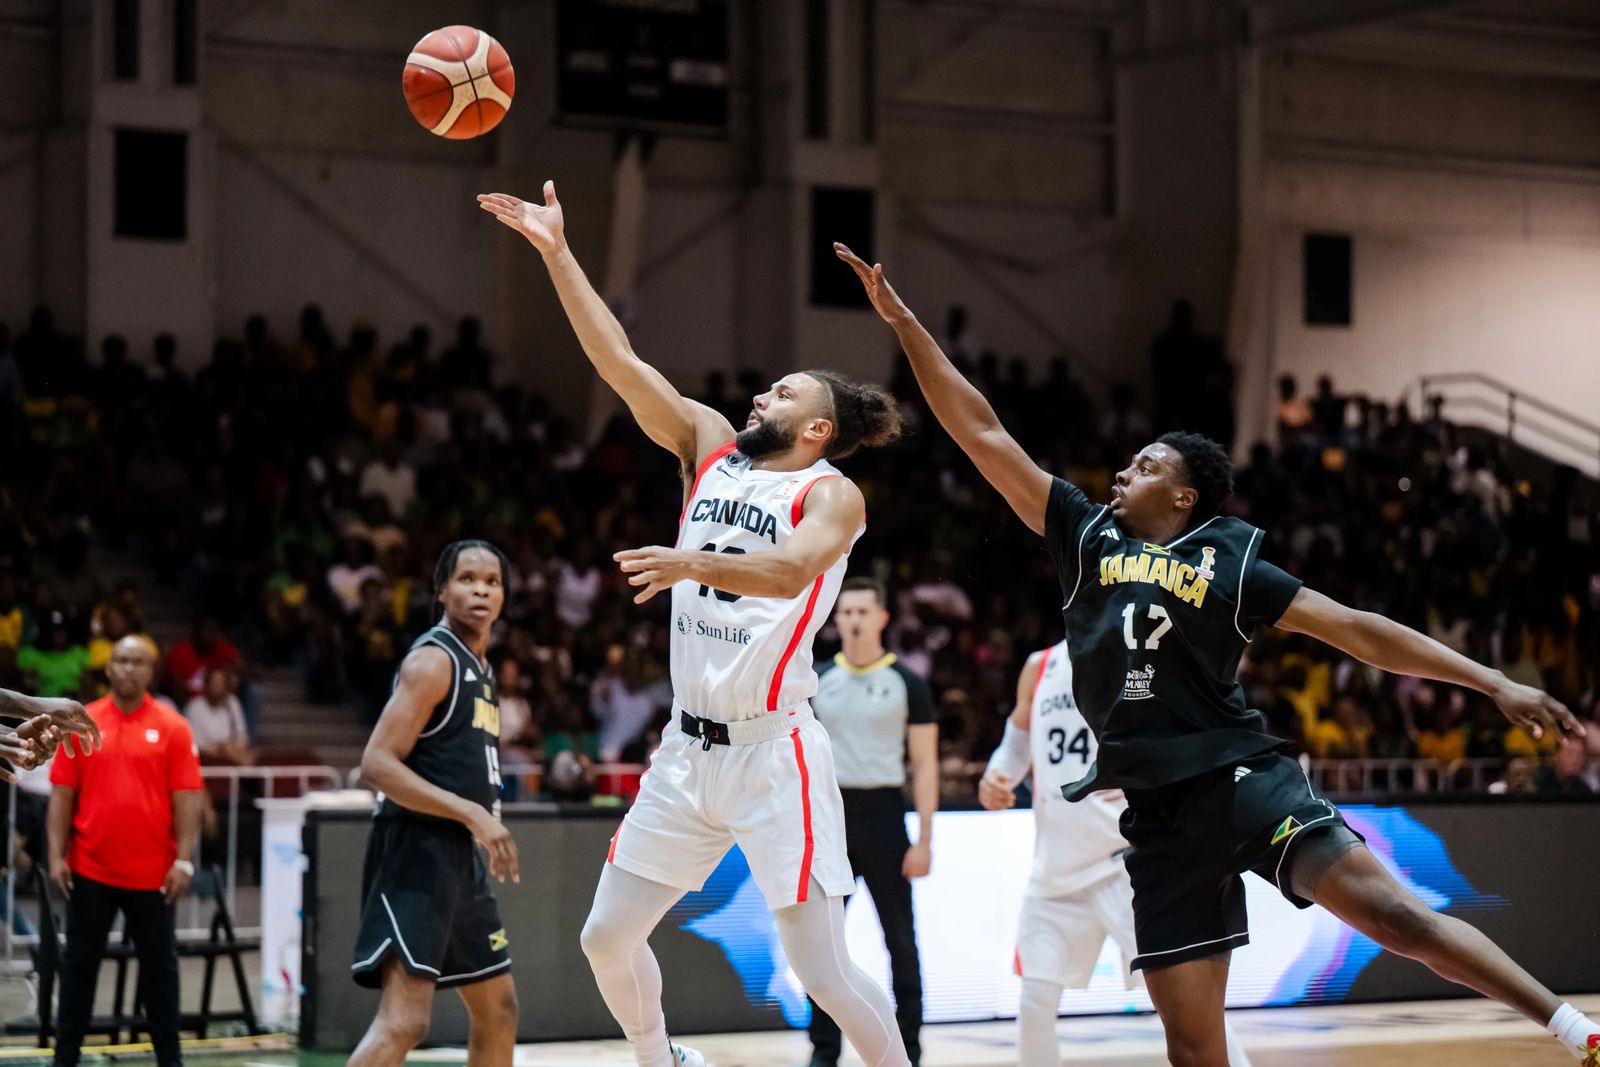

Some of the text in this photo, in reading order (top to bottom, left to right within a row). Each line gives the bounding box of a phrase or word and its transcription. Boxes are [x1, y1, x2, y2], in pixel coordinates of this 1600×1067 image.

[691, 498, 777, 544] CANADA
[1100, 552, 1209, 608] JAMAICA
[696, 620, 751, 645] Sun Life
[1122, 603, 1173, 650] 17
[1048, 727, 1090, 765] 34
